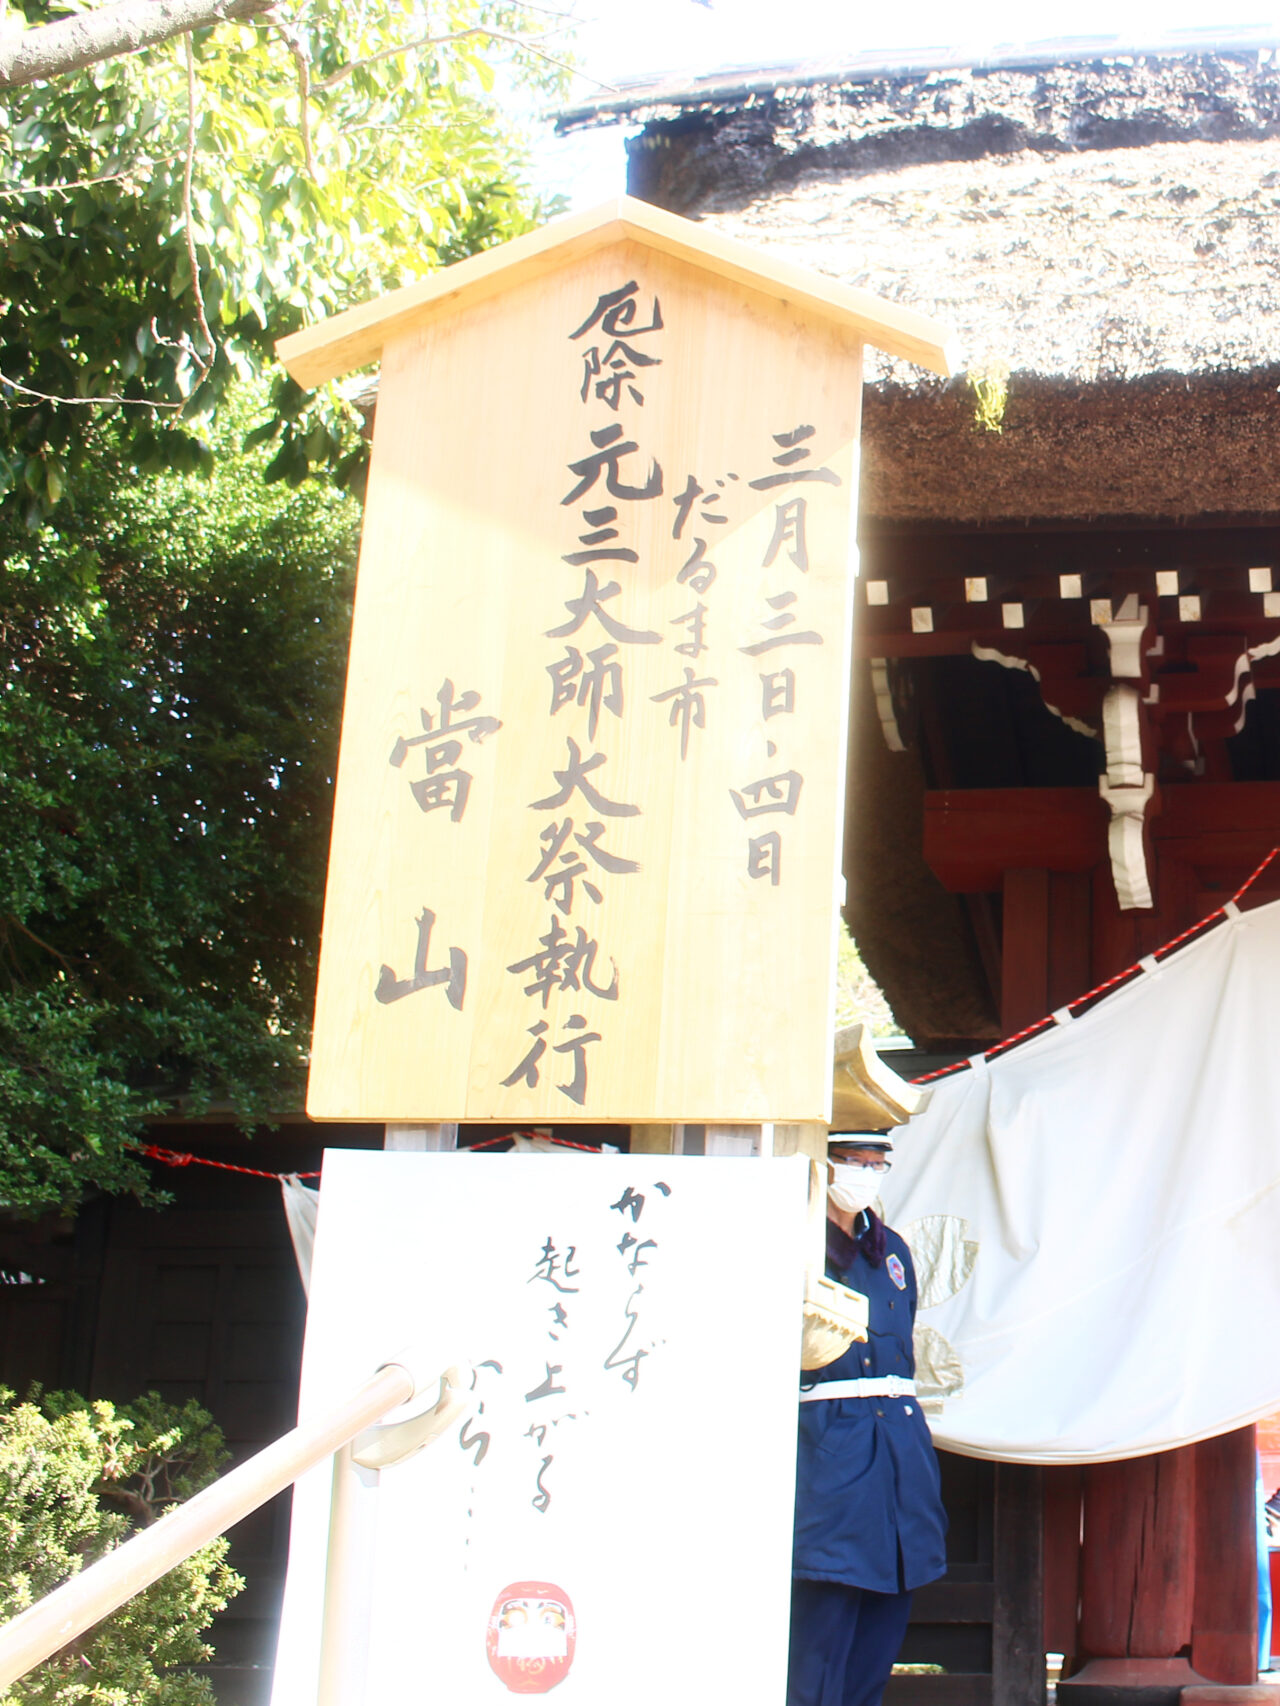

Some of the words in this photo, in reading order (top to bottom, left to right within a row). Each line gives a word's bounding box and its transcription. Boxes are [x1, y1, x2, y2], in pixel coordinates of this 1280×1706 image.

[650, 472, 741, 762] だるま市
[525, 1236, 591, 1514] 起き上がる
[603, 1181, 672, 1393] かならず
